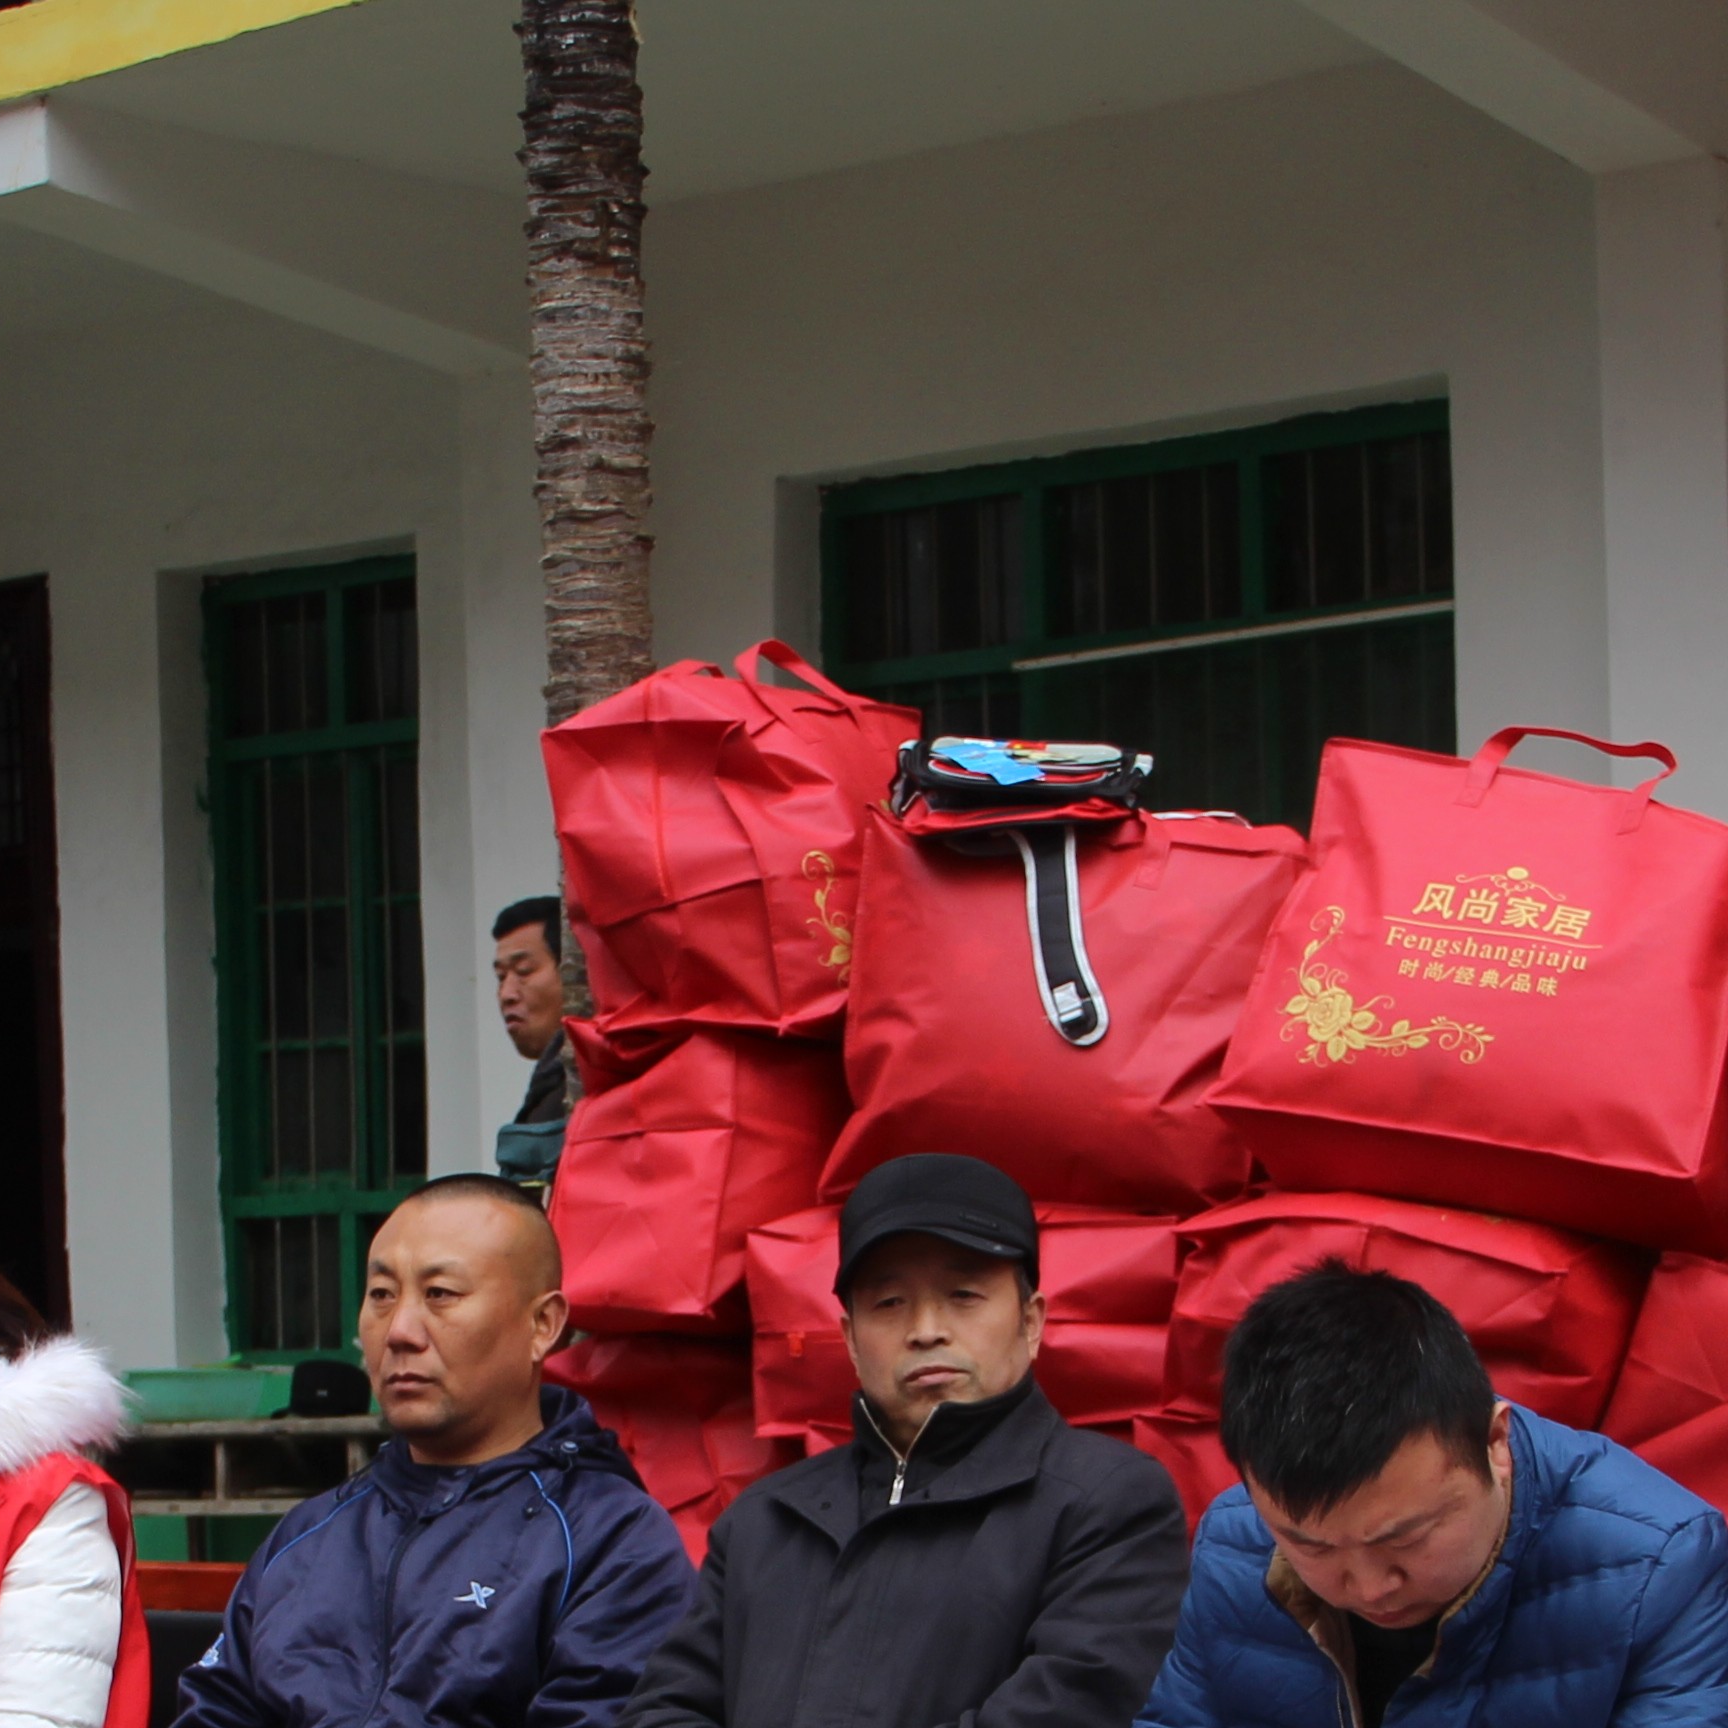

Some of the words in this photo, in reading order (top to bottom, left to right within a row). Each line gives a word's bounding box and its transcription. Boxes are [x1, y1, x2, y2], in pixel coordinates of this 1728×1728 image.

[1412, 882, 1592, 939] 风尚家居
[1385, 925, 1588, 973] Fengshangjiaju
